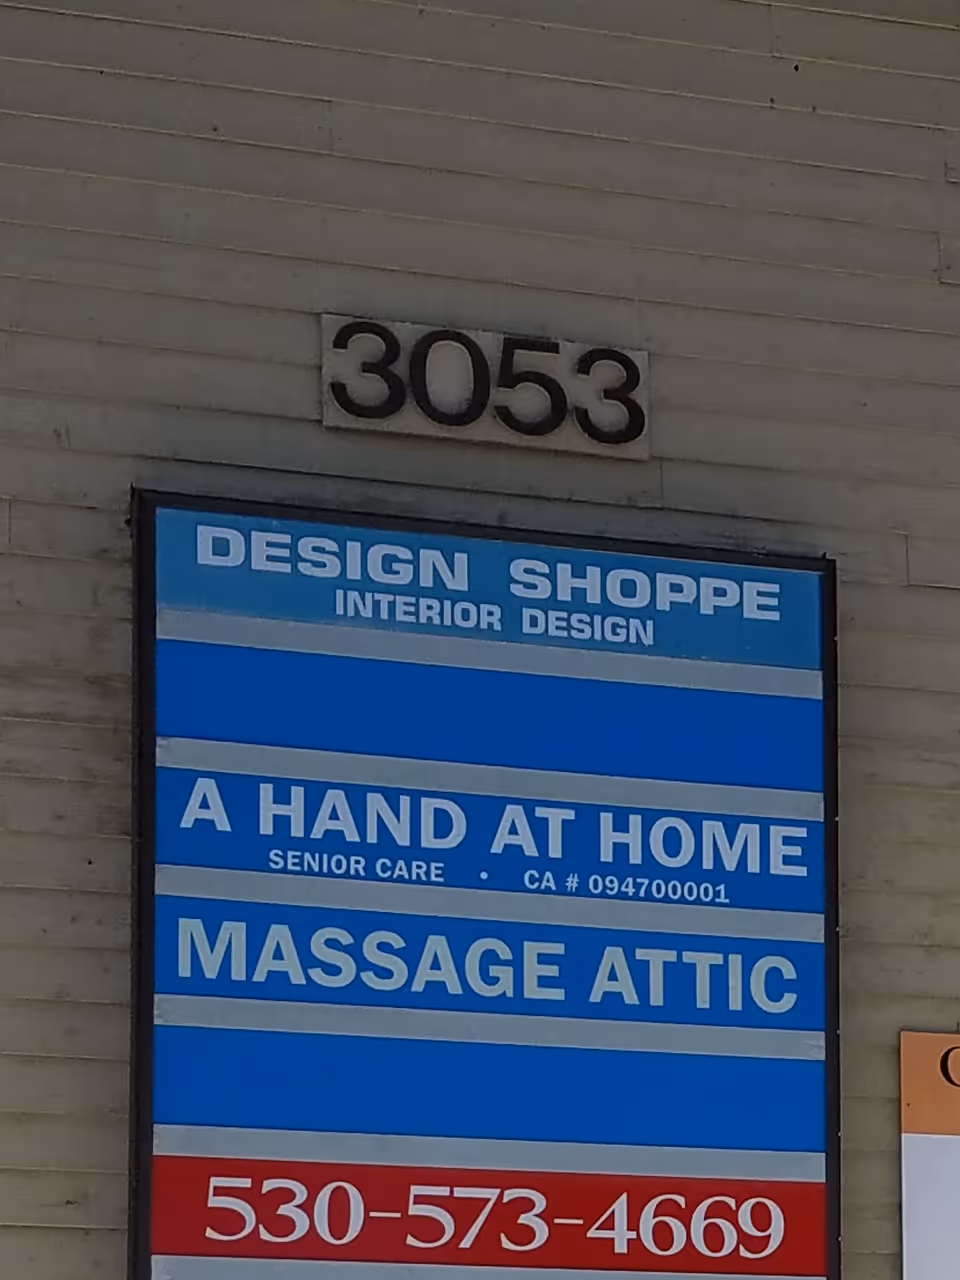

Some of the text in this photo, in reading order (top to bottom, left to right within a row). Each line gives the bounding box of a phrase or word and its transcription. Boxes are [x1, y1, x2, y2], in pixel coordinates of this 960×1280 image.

[330, 321, 646, 444] 3053
[196, 524, 781, 621] DESIGN SHOPPE
[335, 588, 655, 647] INTERIOR DESIGN
[179, 777, 809, 877] A HAND AT HOME
[268, 849, 730, 904] SENIOR CARE CA # 094700001
[177, 917, 799, 1014] MASSAGE ATTIC
[204, 1176, 786, 1259] 530-573-4669
